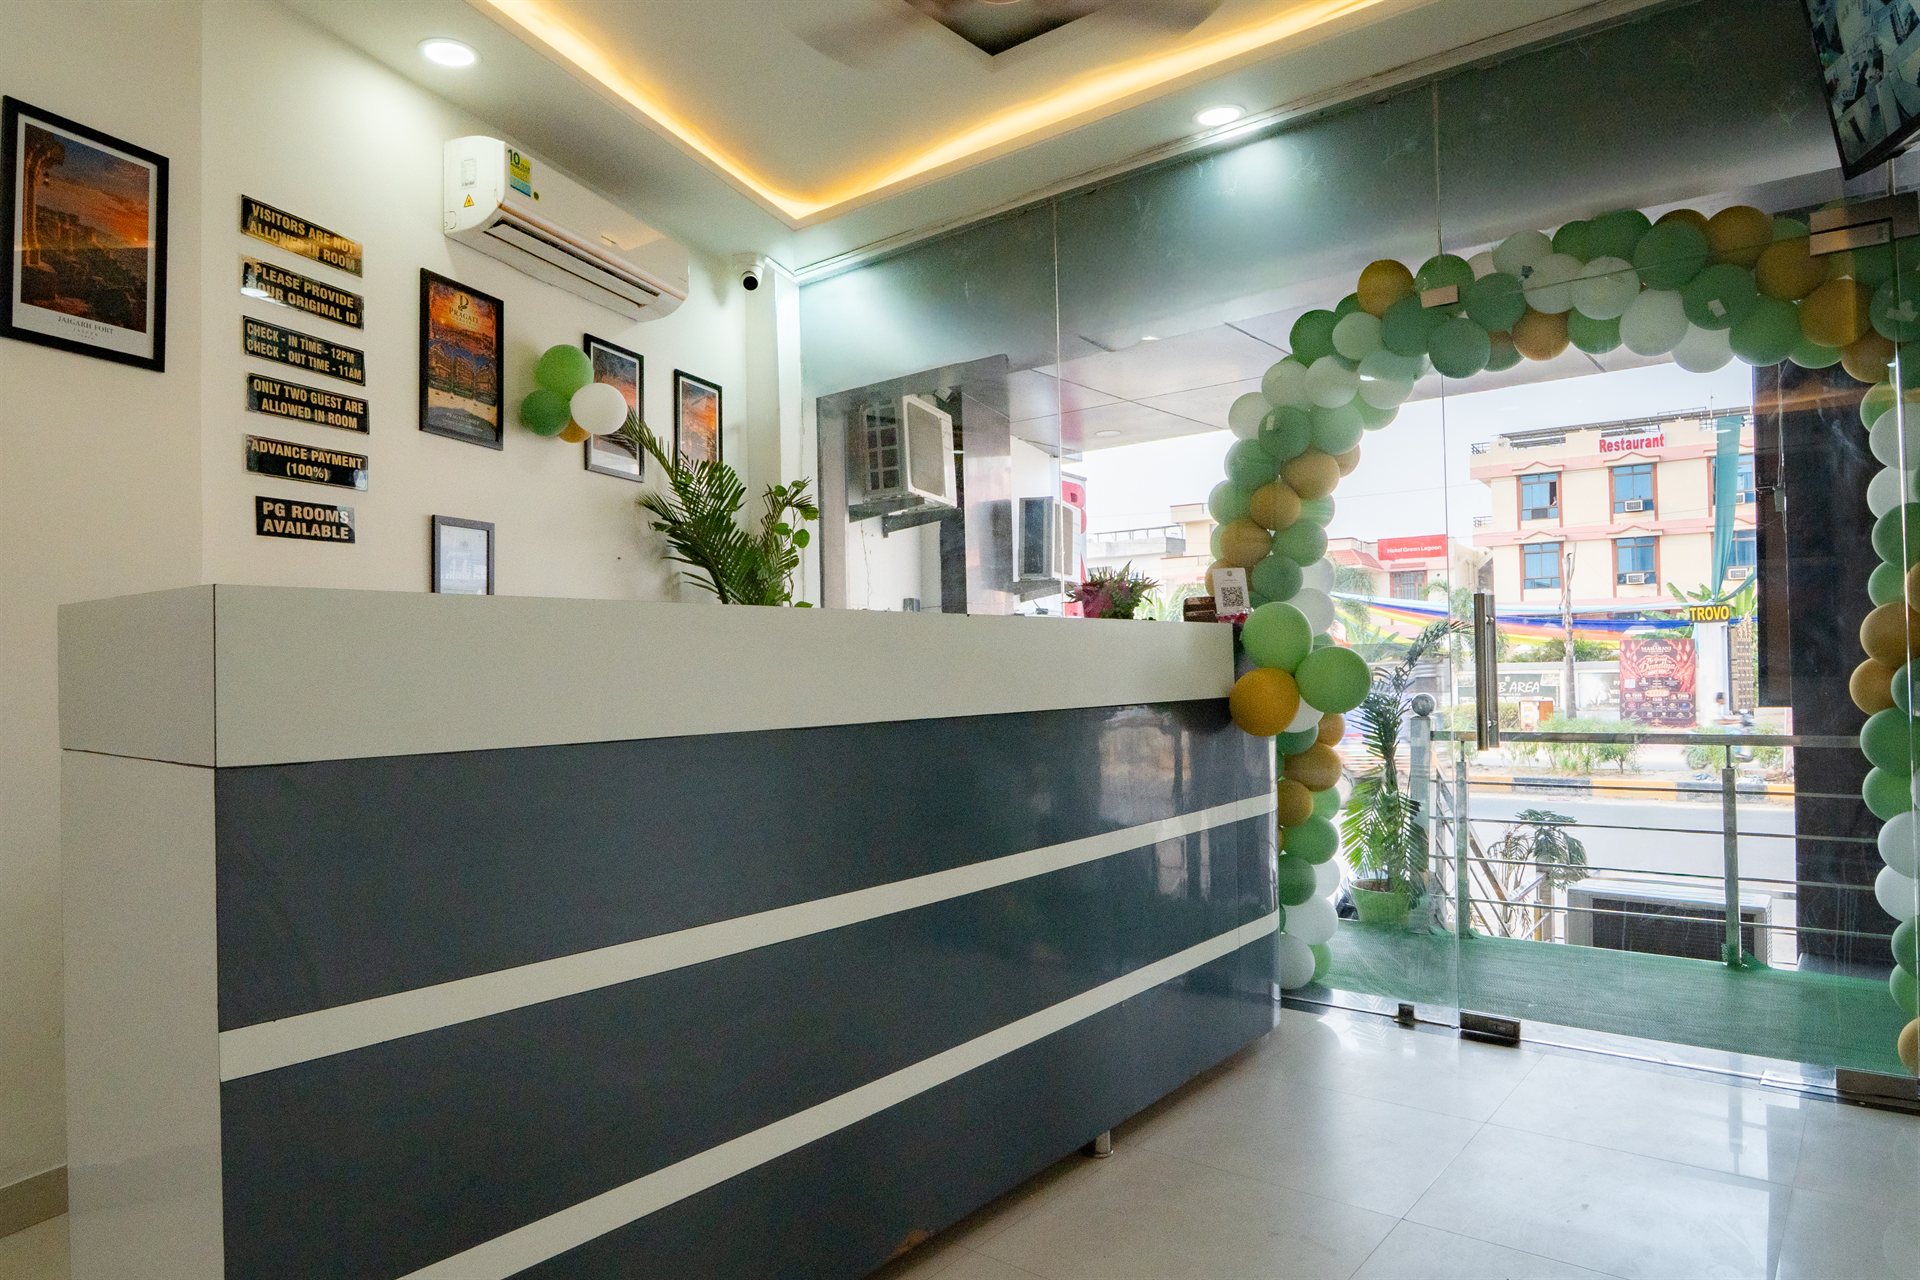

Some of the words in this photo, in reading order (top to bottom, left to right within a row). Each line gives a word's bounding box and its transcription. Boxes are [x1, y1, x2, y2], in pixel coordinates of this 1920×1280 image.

[251, 203, 306, 236] VISITORS
[308, 227, 331, 245] ARE
[323, 250, 356, 271] ROOM
[254, 266, 300, 290] PLEASE
[304, 281, 354, 308] PROVIDE
[288, 293, 342, 320] ORIGINAL
[346, 312, 357, 324] ID
[246, 322, 279, 342] CHECK
[288, 335, 298, 348] IN
[301, 339, 322, 355] TIME
[331, 348, 355, 364] 12PM
[246, 339, 279, 358] CHECK
[288, 351, 306, 365] OUT
[308, 356, 330, 372] TIME
[339, 365, 362, 380] 11AM
[253, 379, 281, 396] ONLY
[284, 385, 308, 402] TWO
[310, 392, 343, 410] GUEST
[345, 401, 364, 415] ARE
[261, 398, 311, 419] ALLOWED
[314, 409, 325, 423] IN
[328, 412, 358, 429] ROOM
[251, 439, 308, 460] ADVANCE
[311, 450, 363, 469] PAYMENT
[1598, 433, 1665, 453] Restaurant
[286, 462, 329, 481] (100%)
[262, 501, 286, 518] PG
[291, 505, 349, 524] ROOMS
[263, 519, 350, 540] AVAILABLE
[1689, 605, 1730, 621] TROVO
[1508, 681, 1540, 693] AREA
